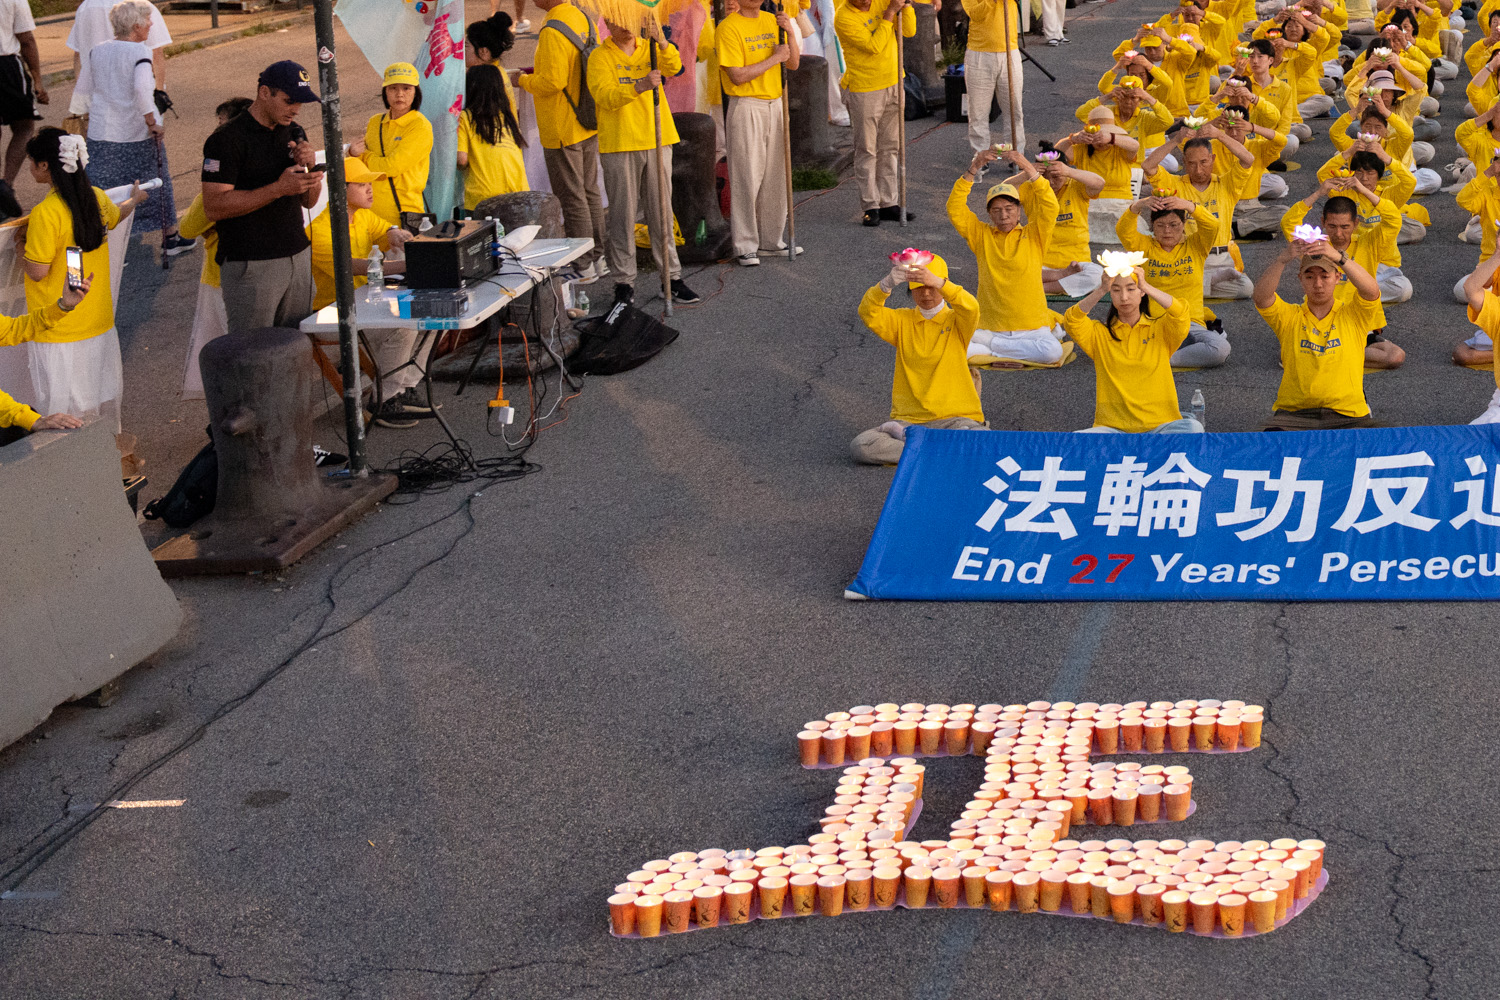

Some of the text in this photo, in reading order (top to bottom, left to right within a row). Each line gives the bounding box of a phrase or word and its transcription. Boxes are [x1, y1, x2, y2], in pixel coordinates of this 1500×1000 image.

[1148, 256, 1193, 269] FALUN DAFA
[1147, 267, 1194, 278] 法輪大法
[952, 546, 1051, 585] End
[1068, 553, 1135, 585] 27
[1151, 553, 1296, 585] Years'
